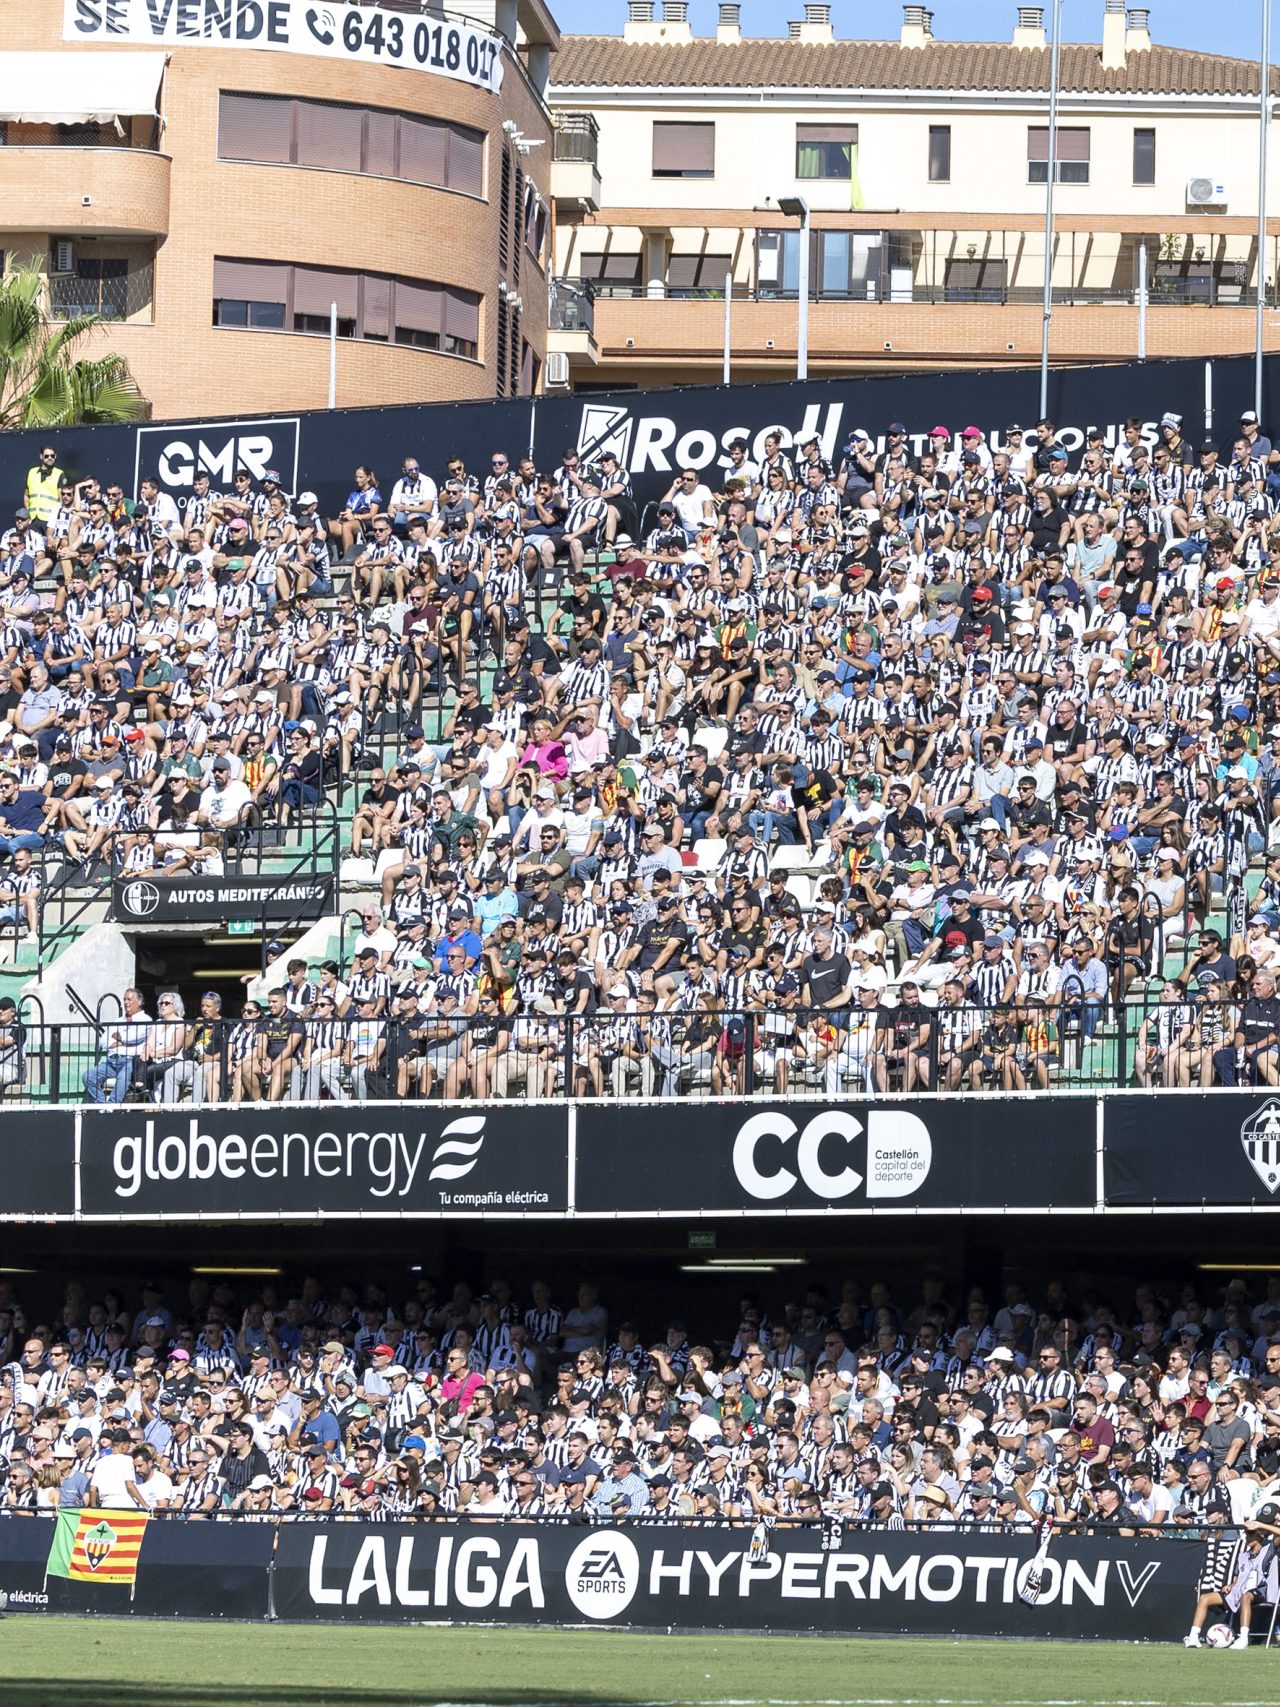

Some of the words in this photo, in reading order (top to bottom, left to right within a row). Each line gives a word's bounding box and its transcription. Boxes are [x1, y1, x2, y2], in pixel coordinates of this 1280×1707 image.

[74, 0, 129, 33] SE
[146, 0, 291, 44] VENDE
[342, 11, 404, 58] 643
[413, 22, 460, 71] 018
[466, 35, 497, 82] 017
[158, 435, 274, 487] GMR
[168, 888, 215, 904] AUTOS
[113, 1118, 428, 1198] globeenergy
[875, 1148, 919, 1160] Castellón
[875, 1160, 908, 1172] capital
[911, 1160, 926, 1170] del
[875, 1171, 913, 1183] deporte
[439, 1191, 451, 1205] Tu
[453, 1190, 503, 1207] compañía
[505, 1190, 549, 1204] eléctrica
[308, 1535, 545, 1608] LALIGA
[649, 1549, 1110, 1606] HYPERMOTION
[1115, 1560, 1162, 1608] V
[579, 1550, 625, 1579] EA
[577, 1580, 626, 1594] SPORTS
[9, 1590, 49, 1604] eléctrica
